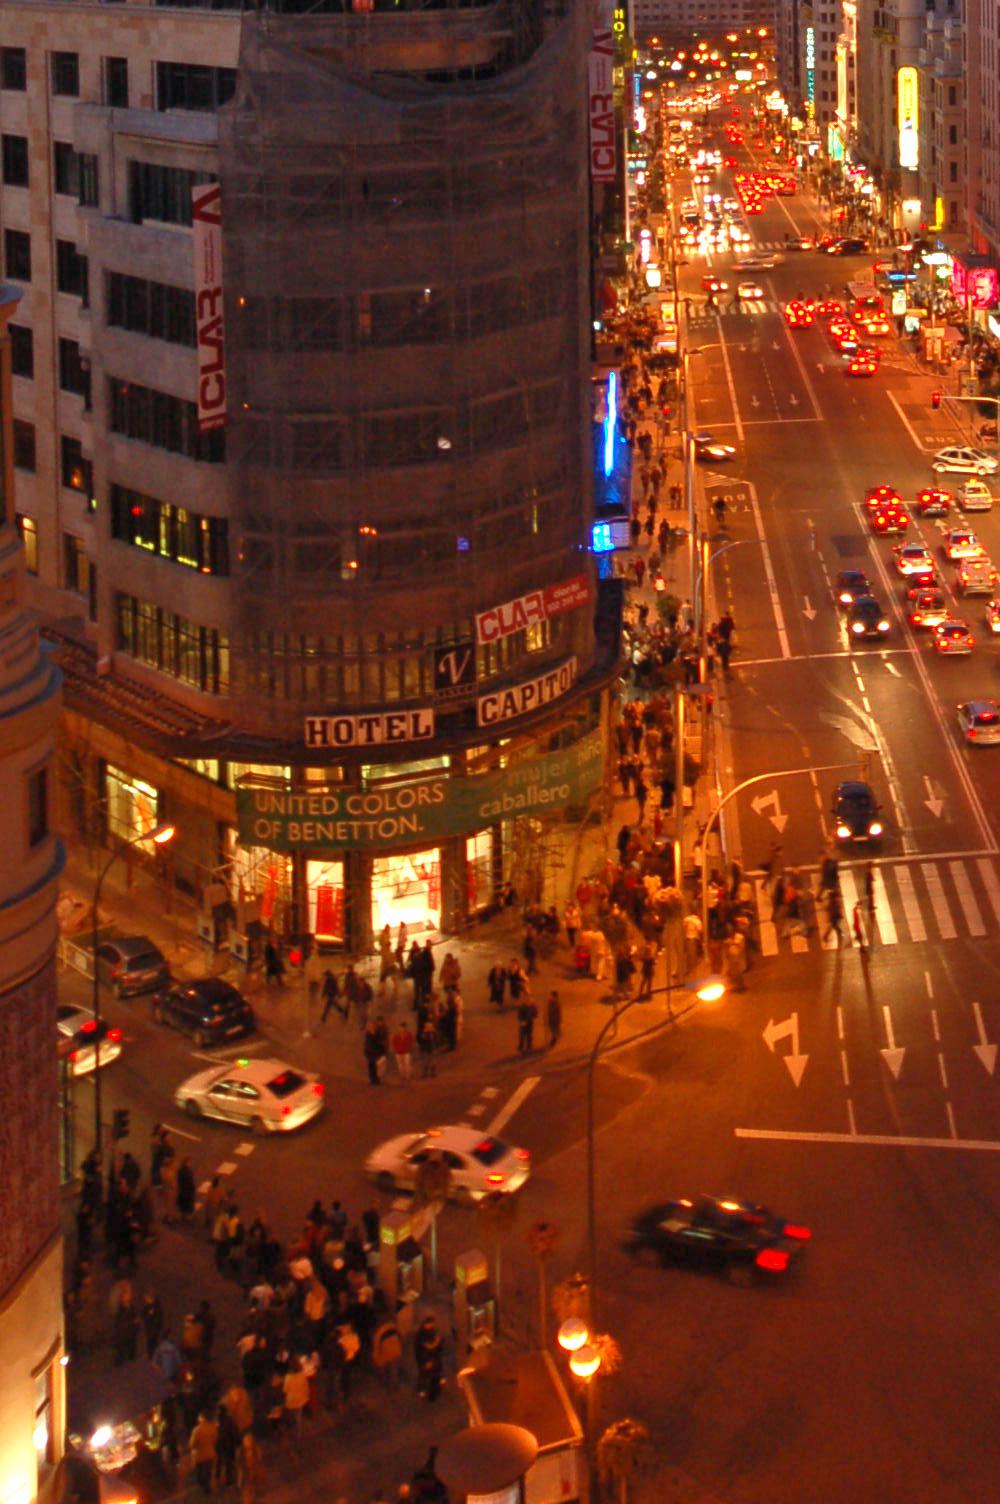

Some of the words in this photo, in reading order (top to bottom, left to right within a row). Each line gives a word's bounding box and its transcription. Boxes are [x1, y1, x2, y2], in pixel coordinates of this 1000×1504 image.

[198, 286, 226, 412] CLAR
[437, 649, 472, 685] V
[307, 711, 433, 746] HOTEL
[254, 793, 339, 816] UNITED
[345, 782, 444, 816] COLORS
[480, 783, 571, 818] caballero
[254, 818, 281, 841] OF
[288, 814, 424, 842] BENETTON.
